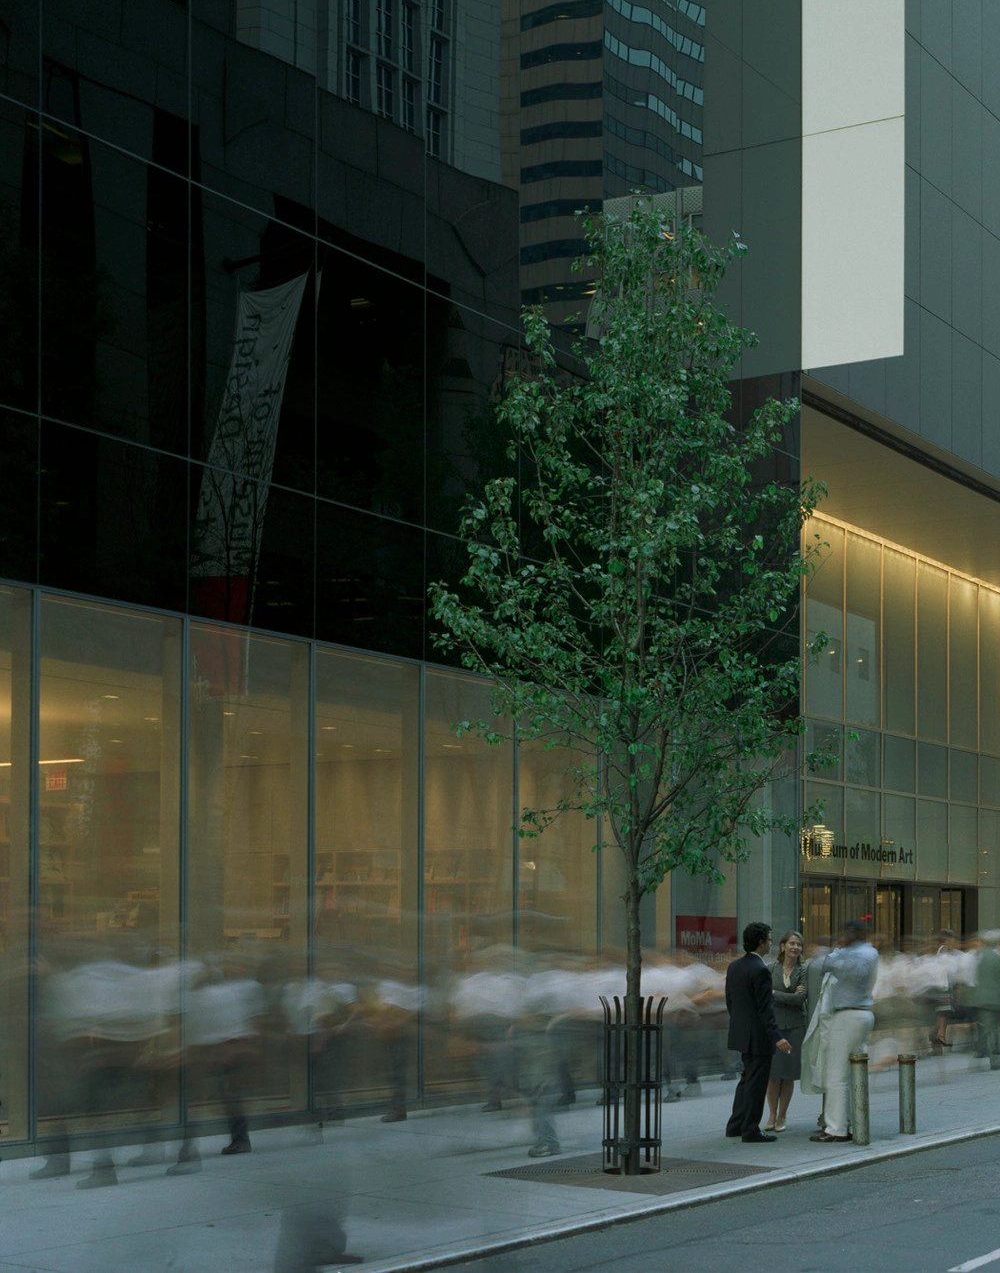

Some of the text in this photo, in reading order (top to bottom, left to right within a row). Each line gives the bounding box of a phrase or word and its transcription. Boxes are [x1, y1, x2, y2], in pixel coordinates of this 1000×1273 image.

[803, 837, 913, 864] Muum of Modern Art
[680, 930, 713, 946] MoMA
[681, 948, 732, 964] sign and
